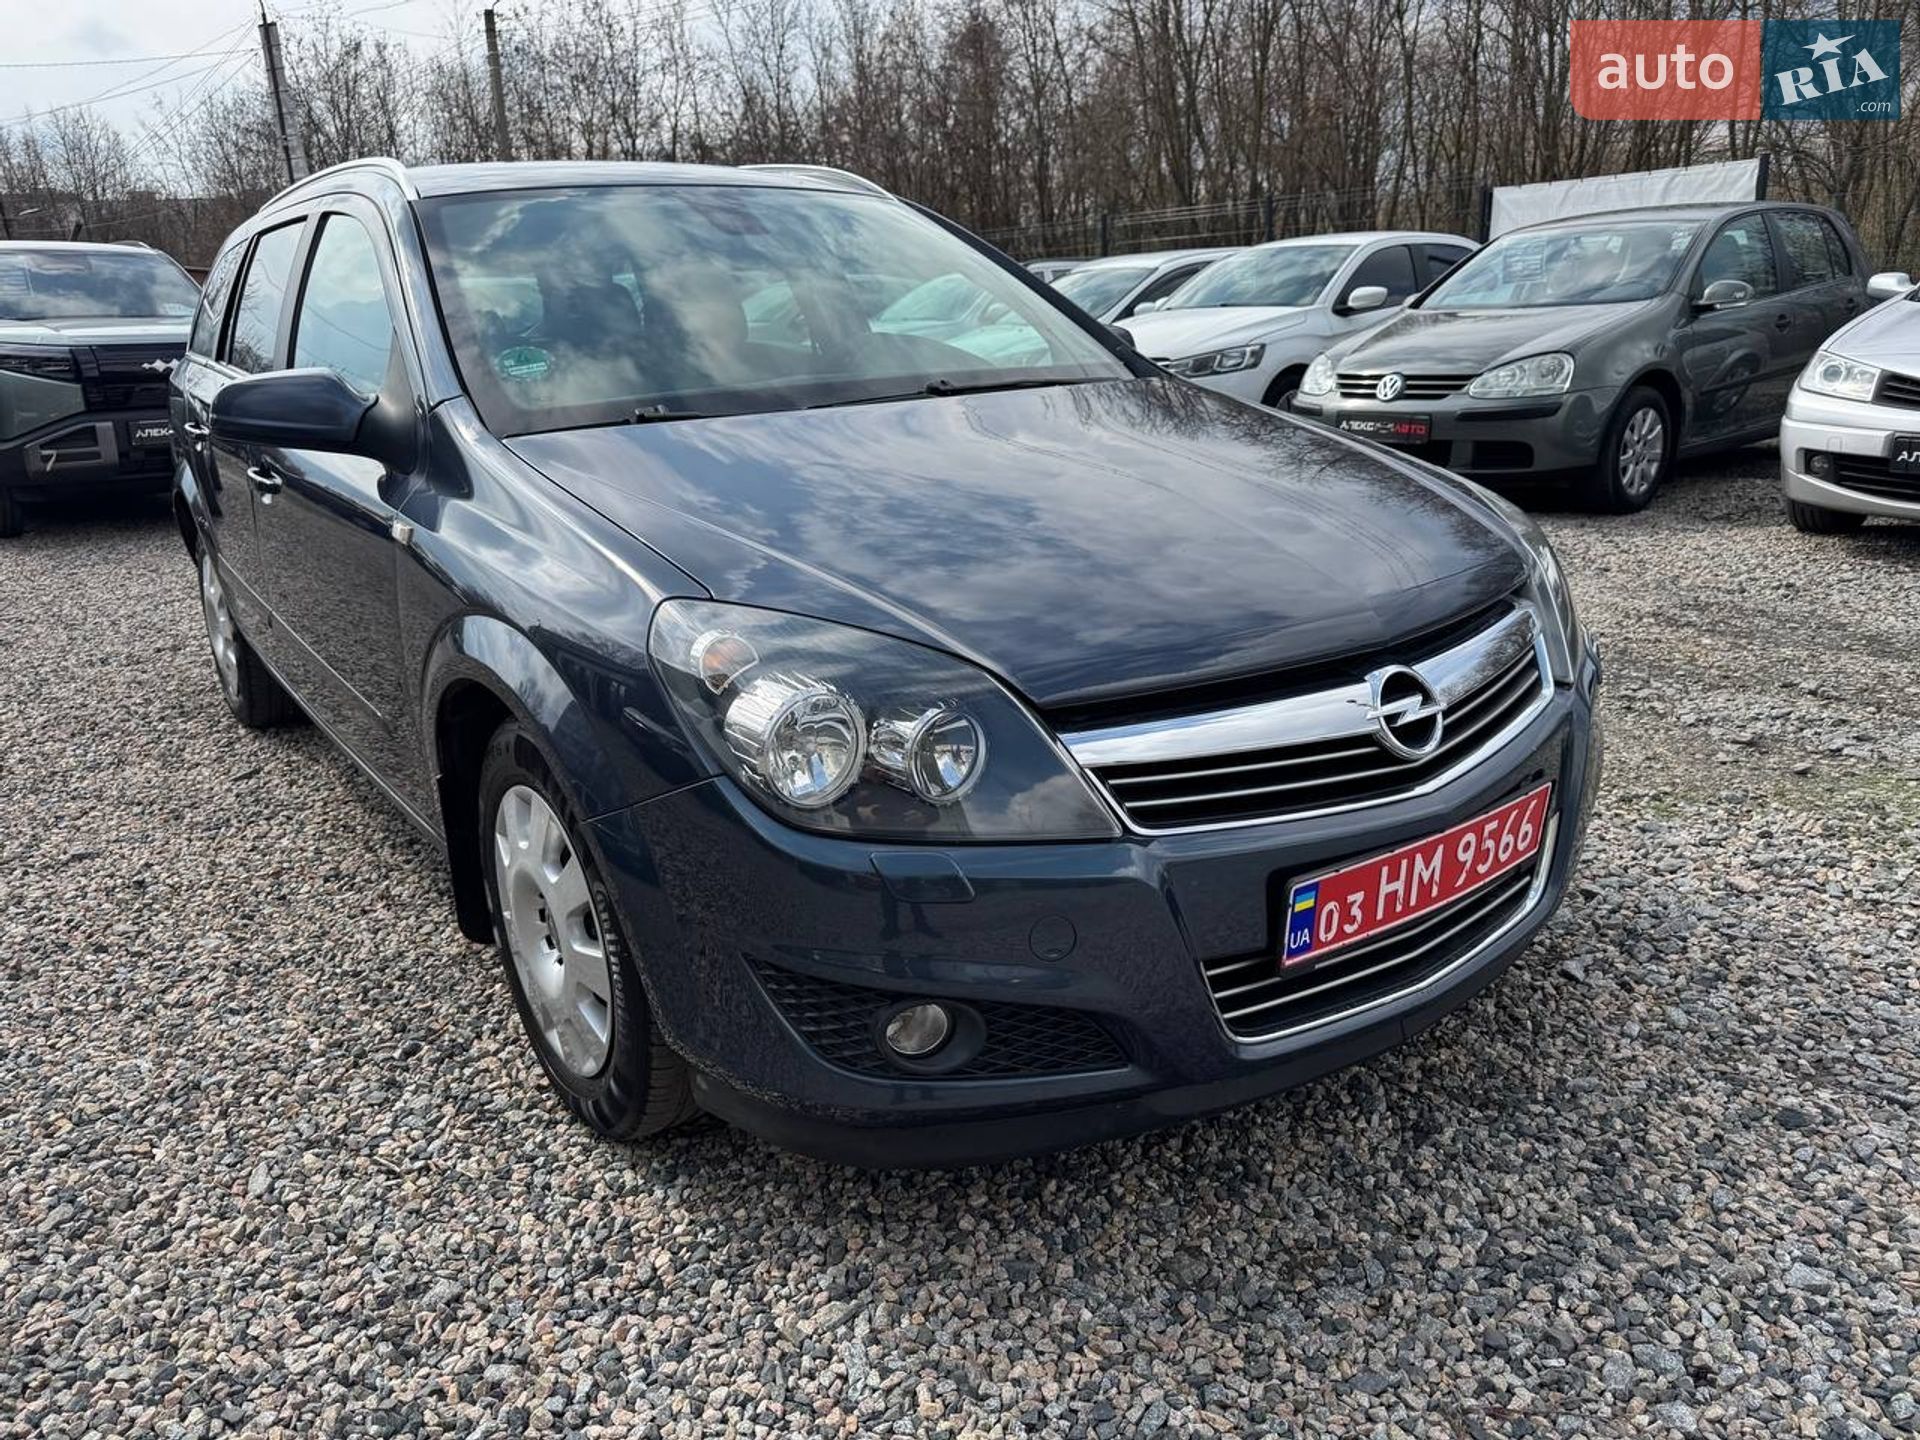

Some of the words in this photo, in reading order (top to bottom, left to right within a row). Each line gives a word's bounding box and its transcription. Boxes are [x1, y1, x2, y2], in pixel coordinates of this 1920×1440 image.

[1318, 891, 1365, 942] 03
[1455, 799, 1538, 888] 9566
[1290, 928, 1311, 949] UA
